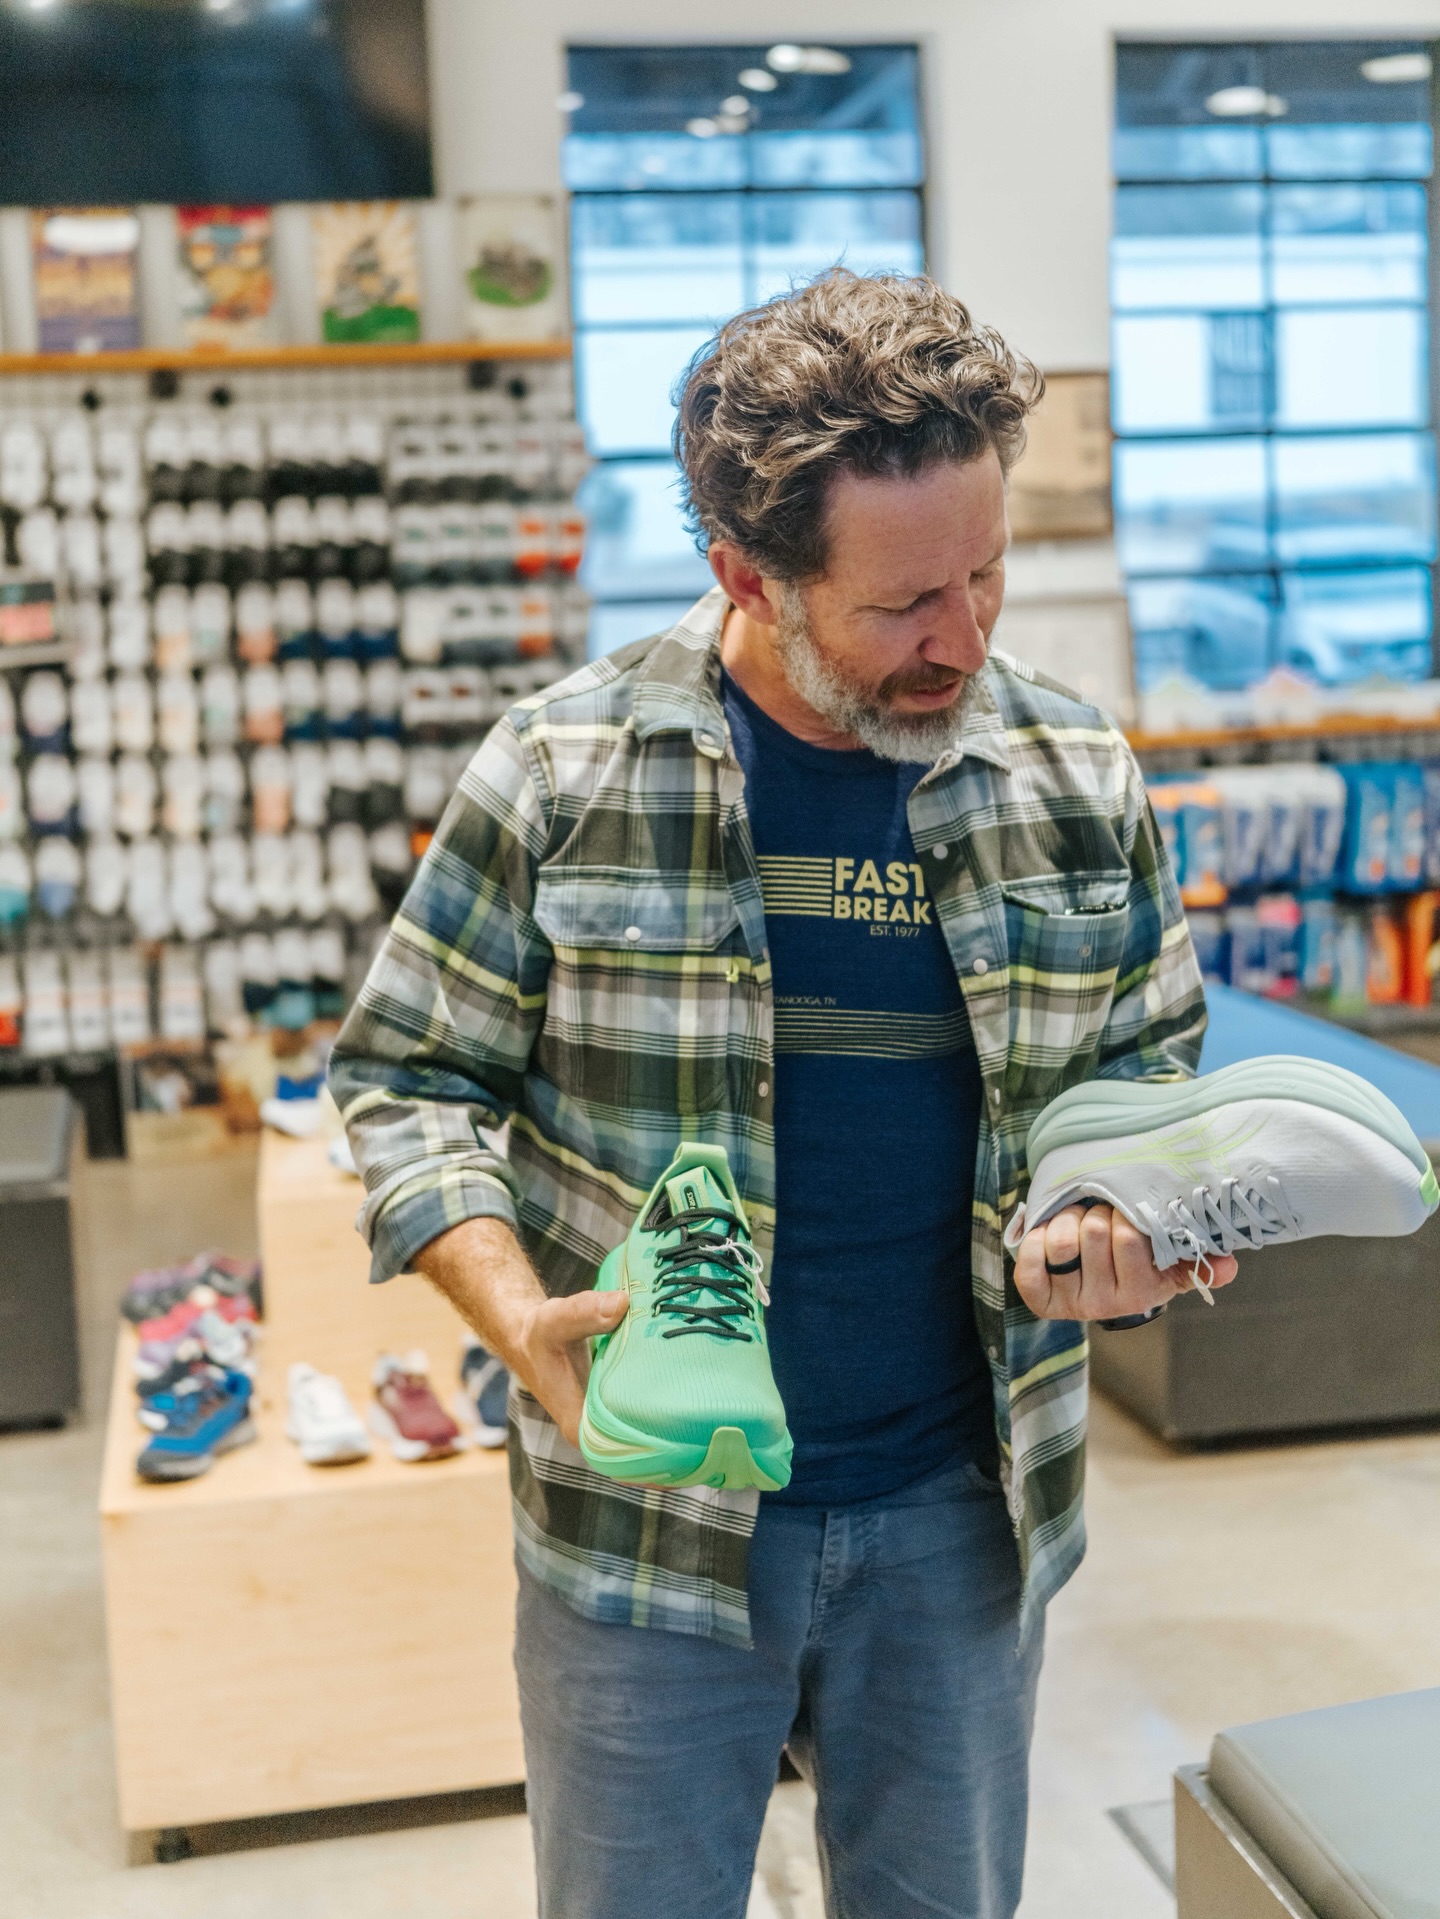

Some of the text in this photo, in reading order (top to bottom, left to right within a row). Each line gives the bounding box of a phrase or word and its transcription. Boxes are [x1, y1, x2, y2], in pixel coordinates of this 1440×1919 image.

[834, 857, 925, 897] FAST
[833, 895, 932, 925] BREAK
[869, 924, 920, 937] EST. 1977
[824, 996, 837, 1006] TN
